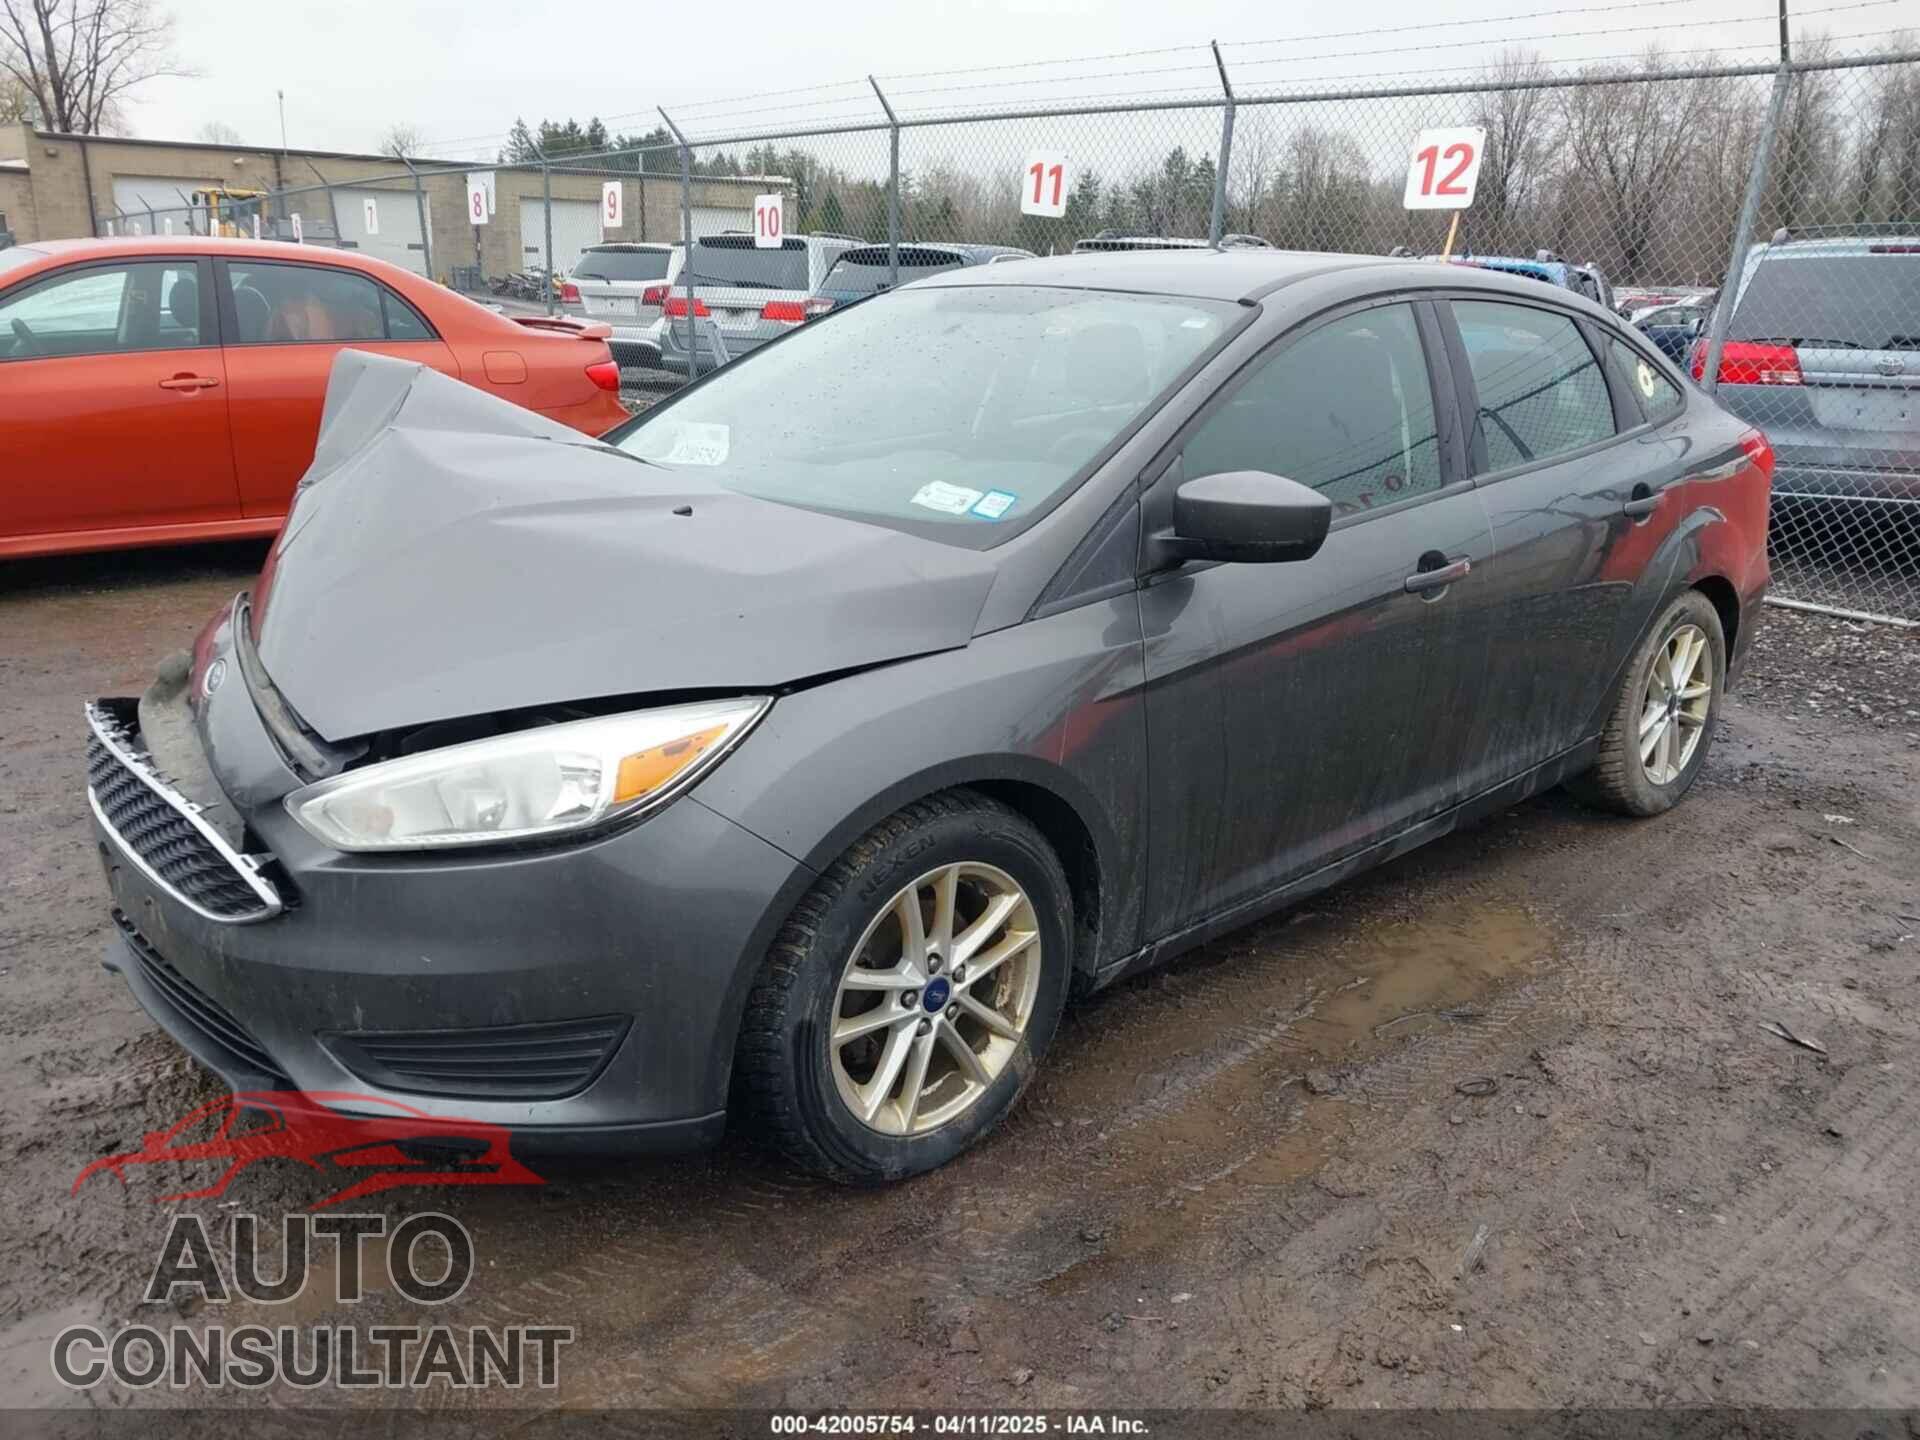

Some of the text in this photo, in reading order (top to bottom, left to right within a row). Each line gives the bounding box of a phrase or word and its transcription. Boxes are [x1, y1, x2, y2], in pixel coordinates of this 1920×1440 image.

[1029, 162, 1064, 206] 11
[1416, 143, 1475, 196] 12
[472, 191, 483, 218] 8
[607, 190, 618, 220] 9
[756, 206, 780, 238] 10
[858, 833, 937, 900] NEXEN
